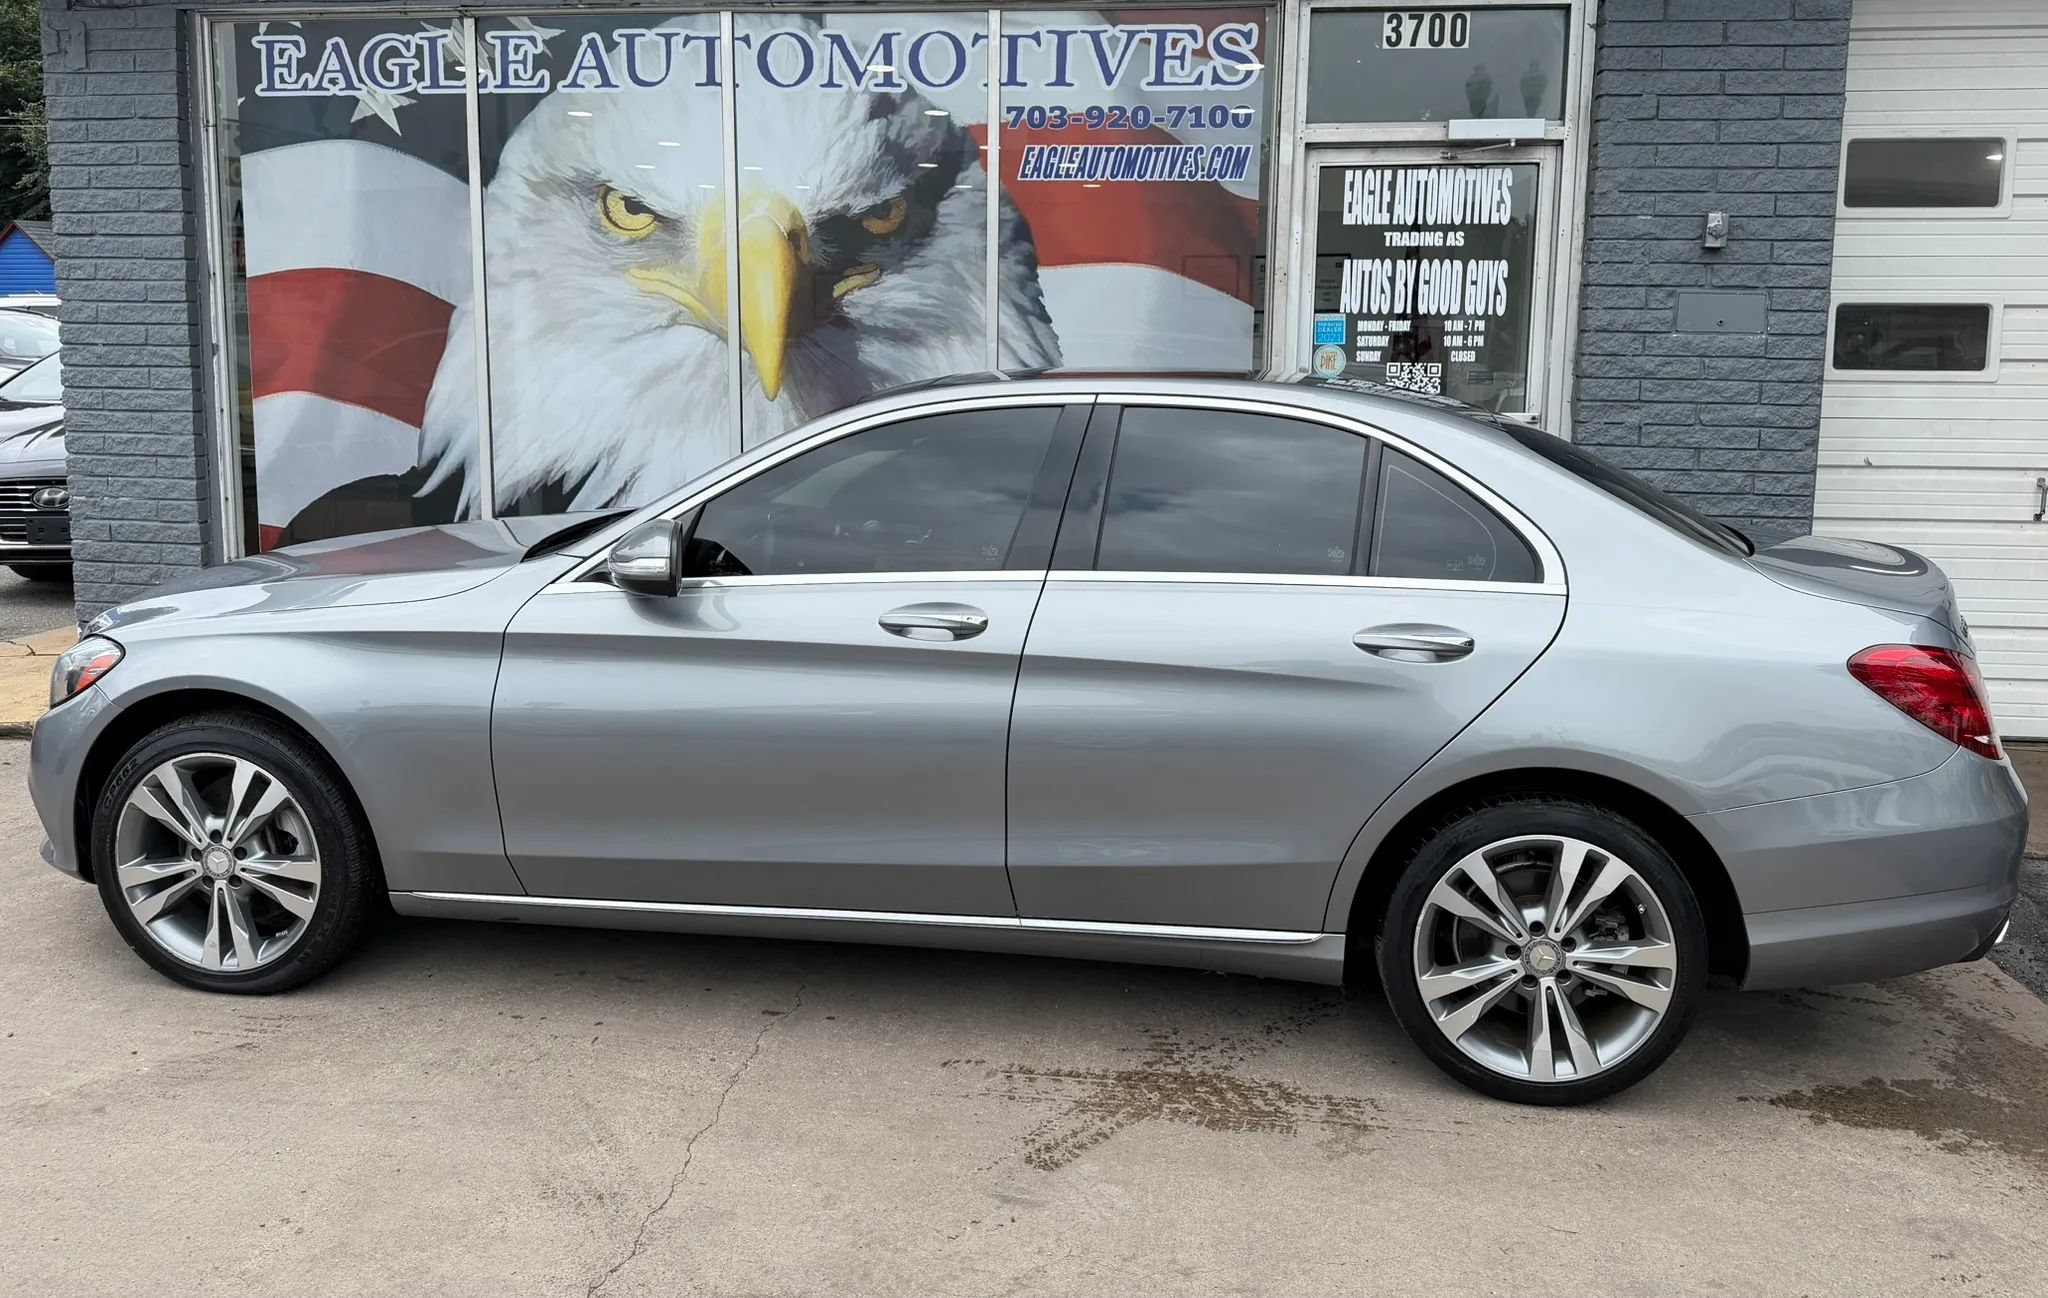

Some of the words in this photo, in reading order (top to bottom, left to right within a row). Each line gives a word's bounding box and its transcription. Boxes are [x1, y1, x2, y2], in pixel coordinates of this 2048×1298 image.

[1385, 13, 1467, 47] 3700
[253, 31, 550, 95] EAGLE
[559, 27, 1261, 93] AUTOMOTIVES
[1006, 105, 1254, 129] 703-920-7100
[1017, 144, 1253, 181] EAGLEAUTOMOTIVES.COM
[1343, 169, 1392, 226] EAGLE
[1392, 168, 1514, 226] AUTOMOTIVES
[1384, 232, 1443, 247] TRADING
[1446, 231, 1464, 247] AS
[1340, 259, 1392, 315] AUTOS
[1394, 259, 1417, 314] BY
[1418, 259, 1463, 316] GOOD
[1465, 259, 1508, 316] GUYS
[1357, 320, 1385, 332] MONDAY
[1388, 320, 1412, 332] FRIDAY
[1444, 320, 1453, 332] 10
[1453, 320, 1464, 332] AM
[1468, 320, 1473, 331] 7
[1474, 320, 1486, 331] PM
[1356, 335, 1390, 347] SATURDAY
[1443, 335, 1452, 347] 10
[1452, 335, 1463, 347] AM
[1467, 335, 1473, 346] 6
[1473, 335, 1485, 347] PM
[1356, 350, 1382, 362] SUNDAY
[1450, 351, 1476, 362] CLOSED
